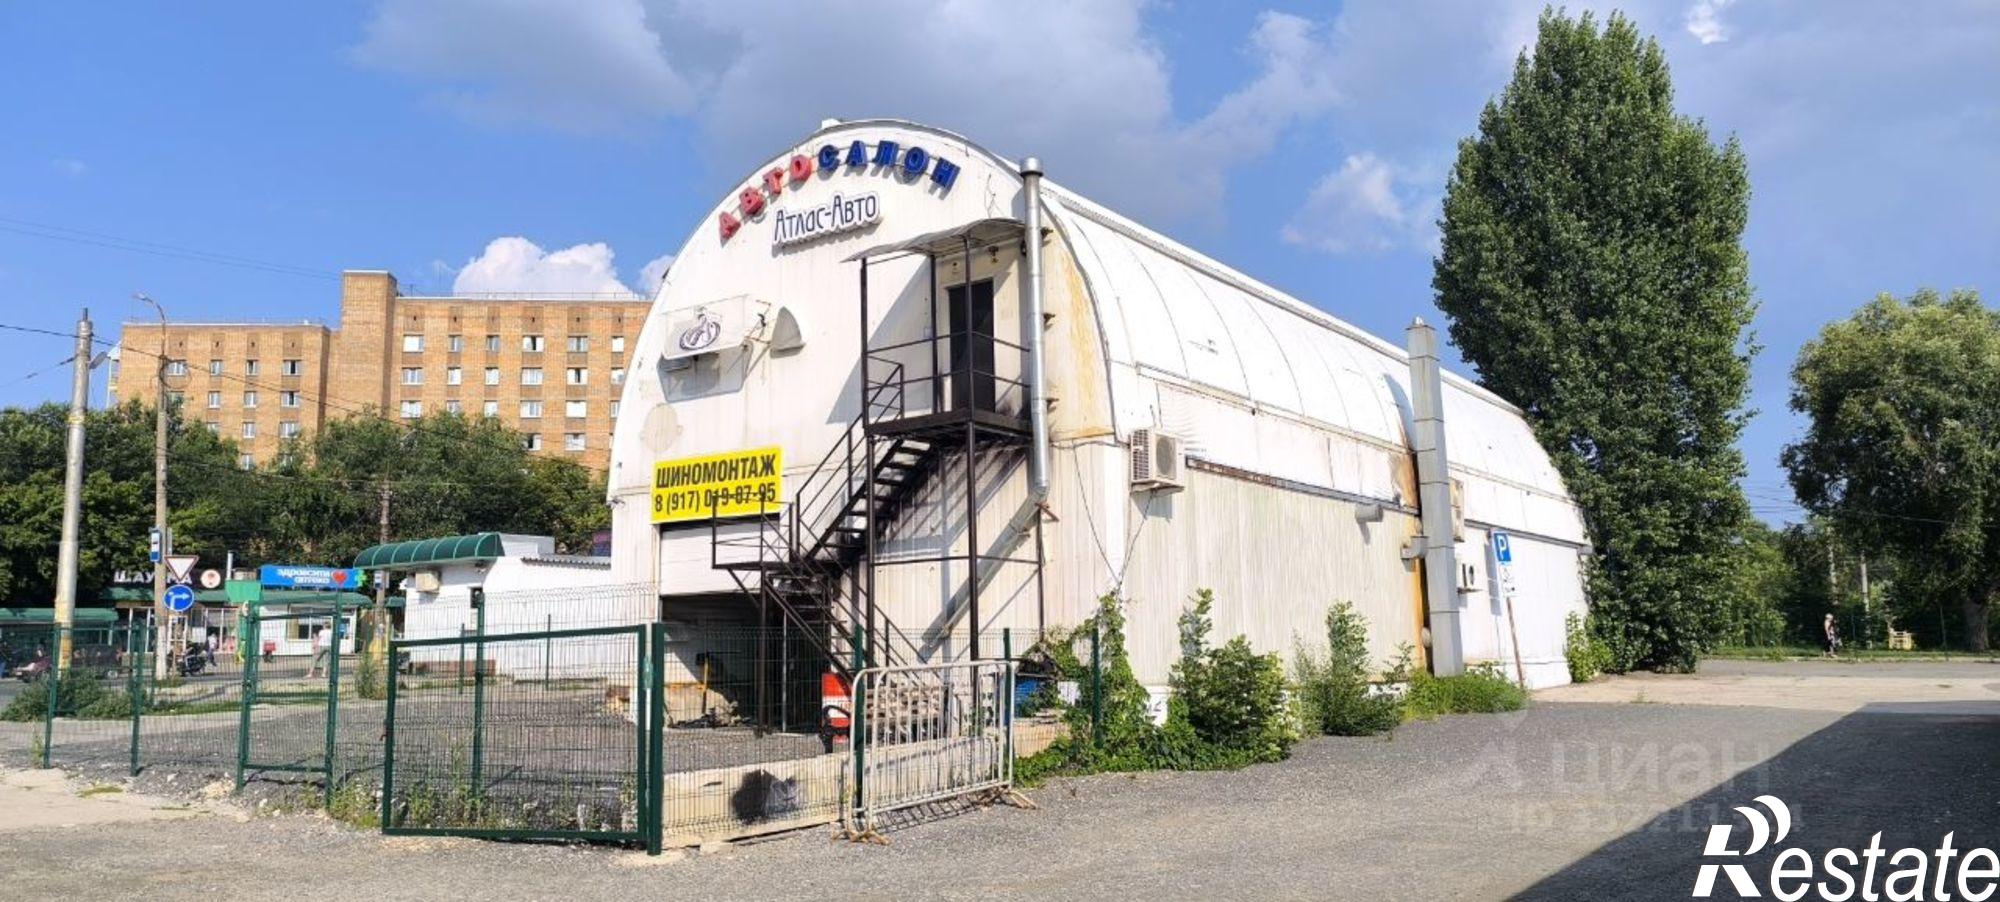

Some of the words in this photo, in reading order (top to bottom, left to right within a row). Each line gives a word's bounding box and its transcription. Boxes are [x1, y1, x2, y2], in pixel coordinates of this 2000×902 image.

[719, 140, 960, 240] АВТОСАЛОН
[656, 454, 776, 488] ШИНОМОНТАЖ
[655, 494, 663, 512] 8
[667, 490, 699, 515] (917)
[114, 570, 192, 584] ШАУМА
